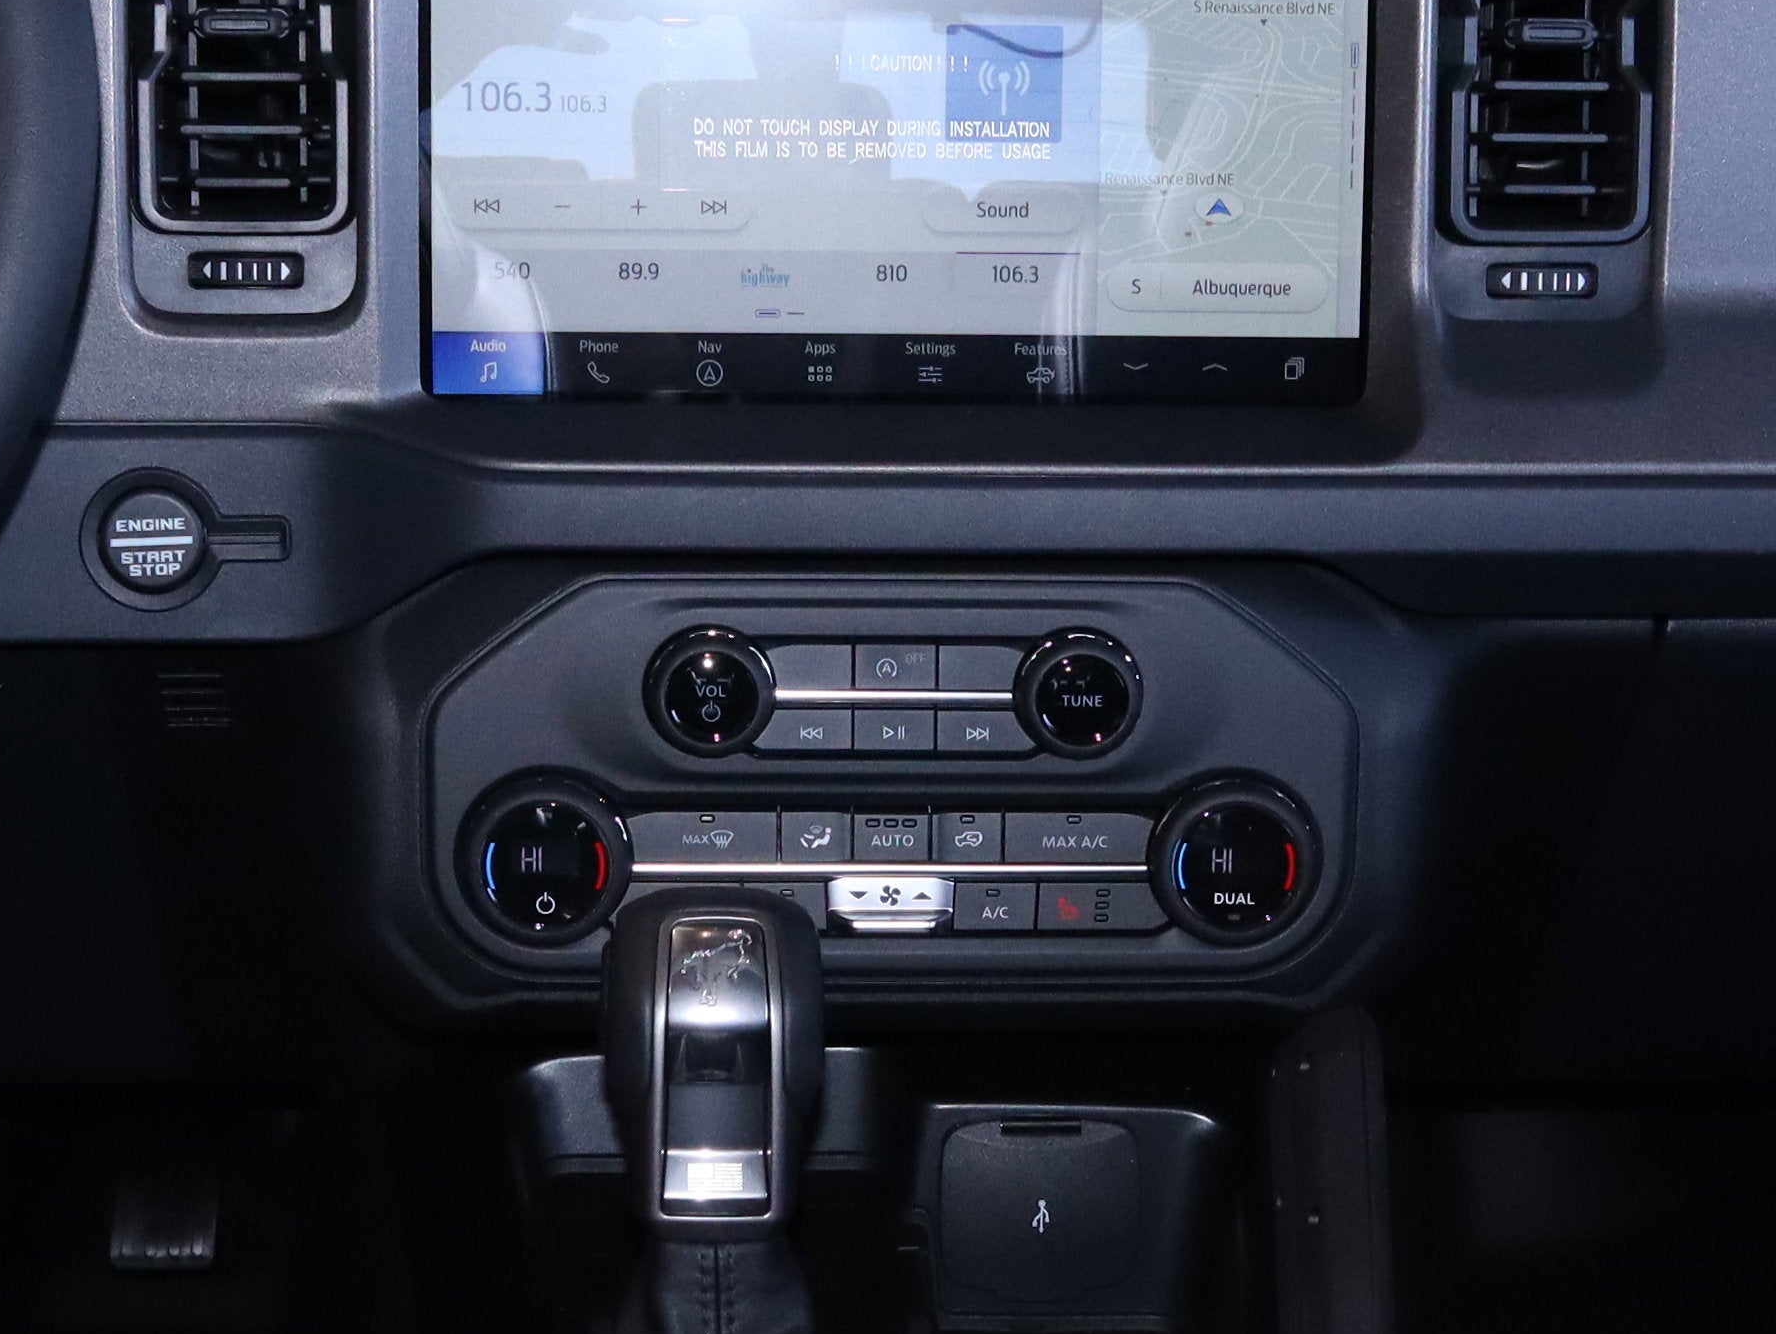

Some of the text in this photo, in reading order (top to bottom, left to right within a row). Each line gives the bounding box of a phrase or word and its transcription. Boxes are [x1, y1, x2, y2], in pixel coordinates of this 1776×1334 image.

[1193, 0, 1334, 15] S Renaissance Blvd NE
[460, 81, 608, 113] 106.3 106.3
[693, 117, 1050, 138] DO NOT TOUCH DISPLAY DURING INSTALLATION
[694, 140, 1051, 159] THIS FILM IS TO BE REMOVED BEFORE USAGE
[1105, 171, 1235, 185] Renaissance Blvd NE
[976, 201, 1030, 219] Sound
[494, 262, 530, 280] 540
[618, 263, 660, 281] 89.9
[740, 267, 790, 287] highway
[876, 265, 908, 283] 810
[992, 266, 1039, 285] 106.3
[1131, 279, 1292, 299] S Albuquerque
[470, 339, 506, 353] Audio
[579, 340, 619, 353] Phone
[698, 341, 722, 353] Nav
[804, 341, 836, 357] Apps
[905, 342, 956, 358] Settings
[1014, 343, 1068, 356] Features
[114, 517, 186, 533] ENGINE
[120, 549, 186, 565] START
[128, 563, 182, 577] STOP
[904, 653, 926, 664] OFF
[696, 685, 726, 699] VOL
[1062, 695, 1102, 708] TUNE
[682, 834, 710, 845] MAX
[871, 834, 914, 847] AUTO
[1042, 835, 1108, 849] MAX A/C
[520, 847, 544, 873] HI
[1212, 847, 1232, 873] HI
[1214, 892, 1256, 905] DUAL
[982, 906, 1009, 919] A/C
